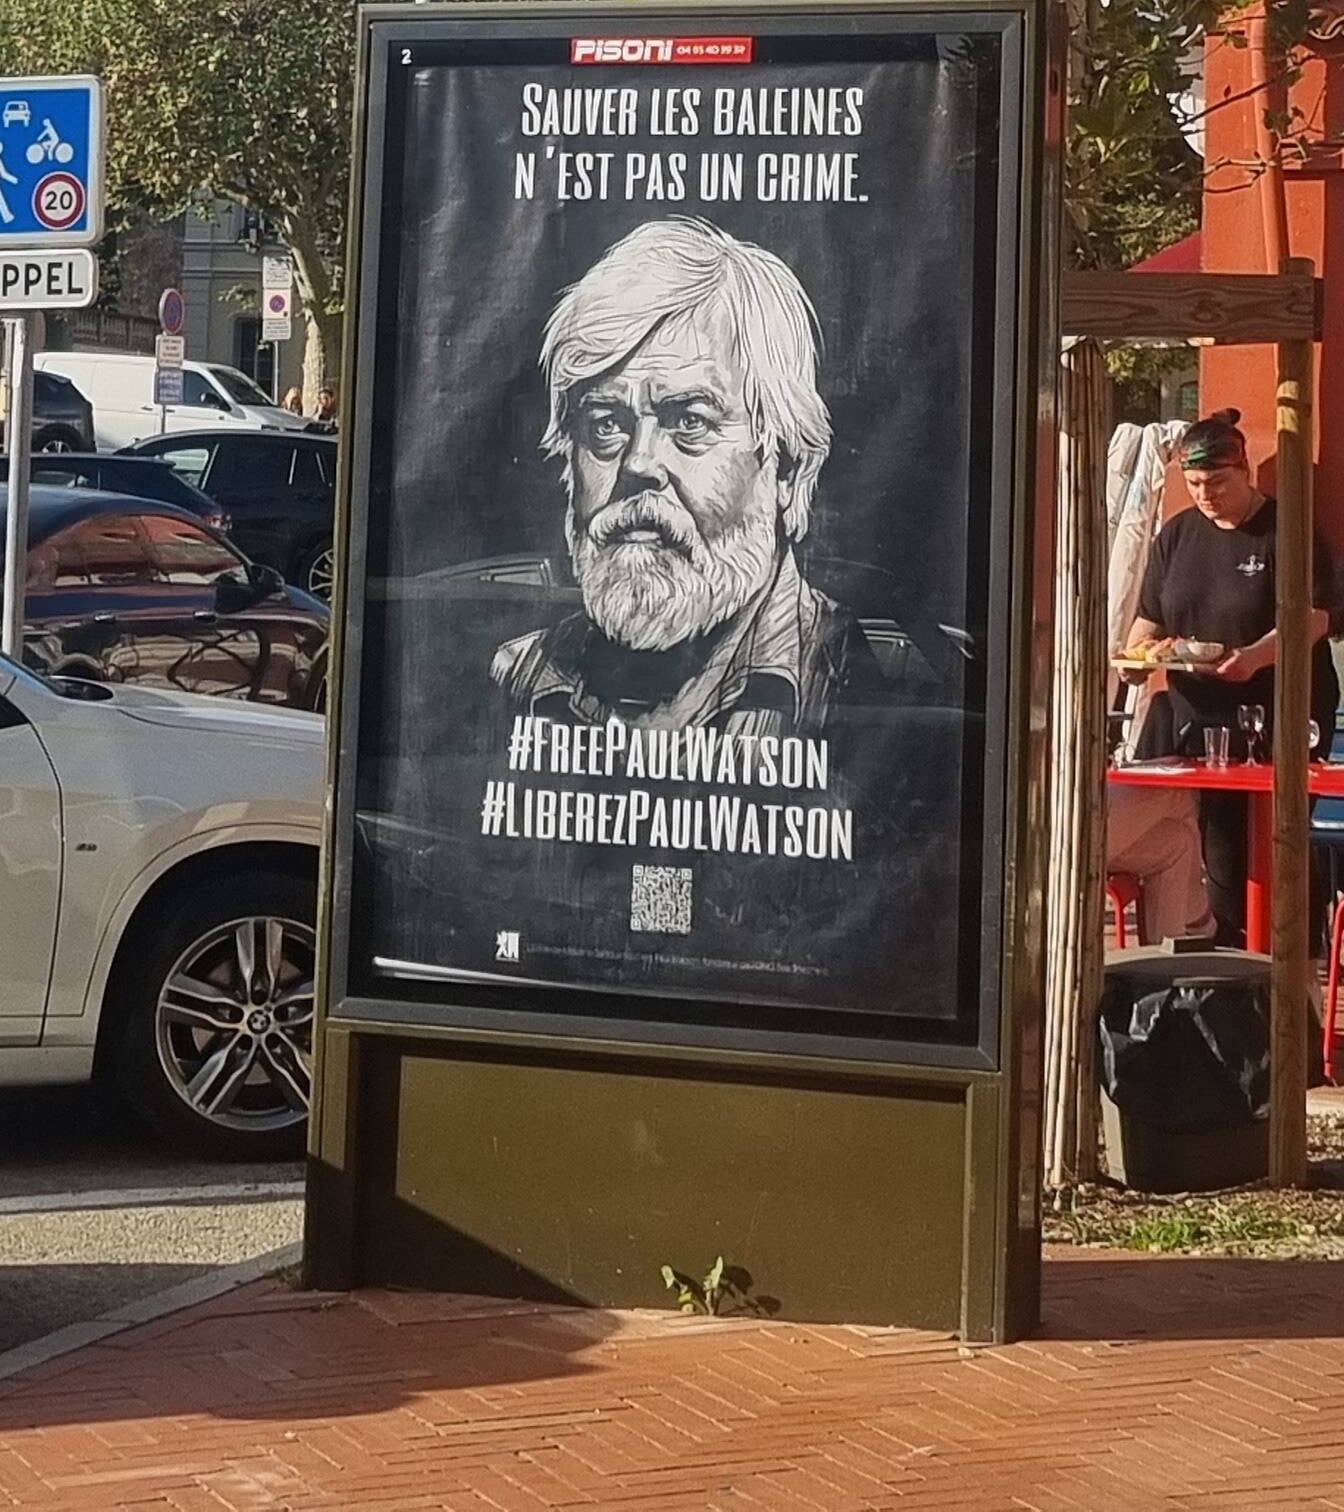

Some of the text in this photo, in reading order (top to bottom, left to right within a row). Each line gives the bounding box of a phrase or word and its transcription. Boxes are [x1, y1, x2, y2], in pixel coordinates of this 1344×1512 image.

[401, 49, 413, 65] 2
[650, 88, 702, 136] LES
[713, 88, 864, 136] BALEINES
[625, 152, 687, 200] PAS
[700, 152, 743, 200] UN
[757, 152, 869, 202] CRIME.
[44, 191, 74, 210] 20
